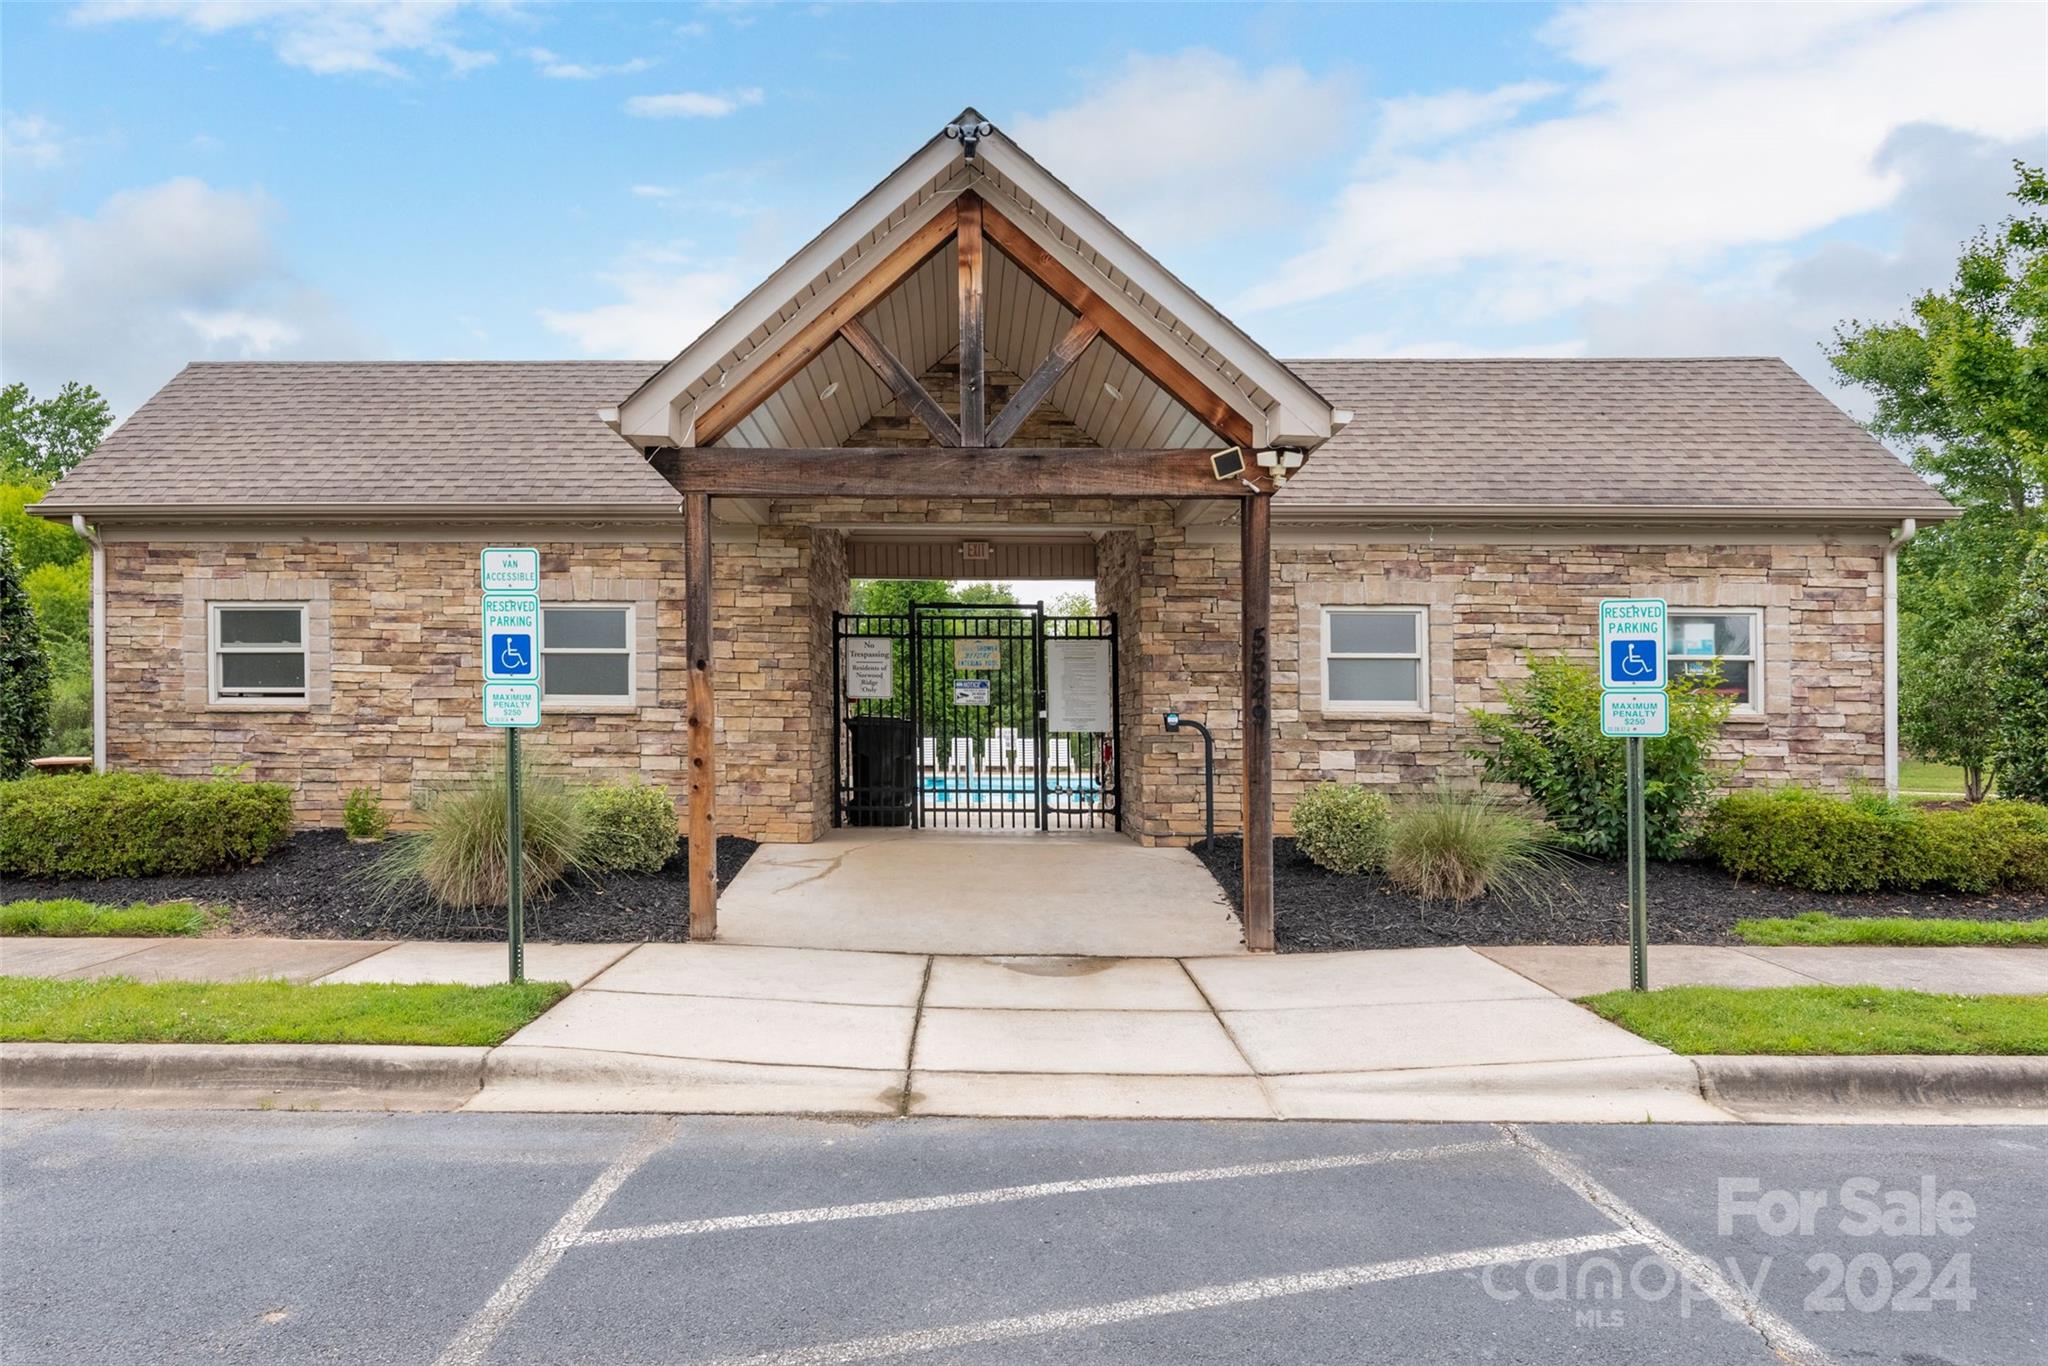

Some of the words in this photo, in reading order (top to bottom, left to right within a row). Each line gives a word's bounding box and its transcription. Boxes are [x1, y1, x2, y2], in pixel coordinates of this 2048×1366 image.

[967, 543, 985, 557] EXIT
[502, 560, 518, 568] VAN
[486, 572, 534, 581] ACCESSIBLE
[486, 601, 535, 612] RESERVED
[1604, 606, 1661, 618] RESERVED
[490, 616, 532, 627] PARKING
[1608, 622, 1658, 633] PARKING
[849, 649, 890, 659] Trespassing
[861, 679, 878, 687] Ridge
[1612, 702, 1658, 710] MAXIMUM
